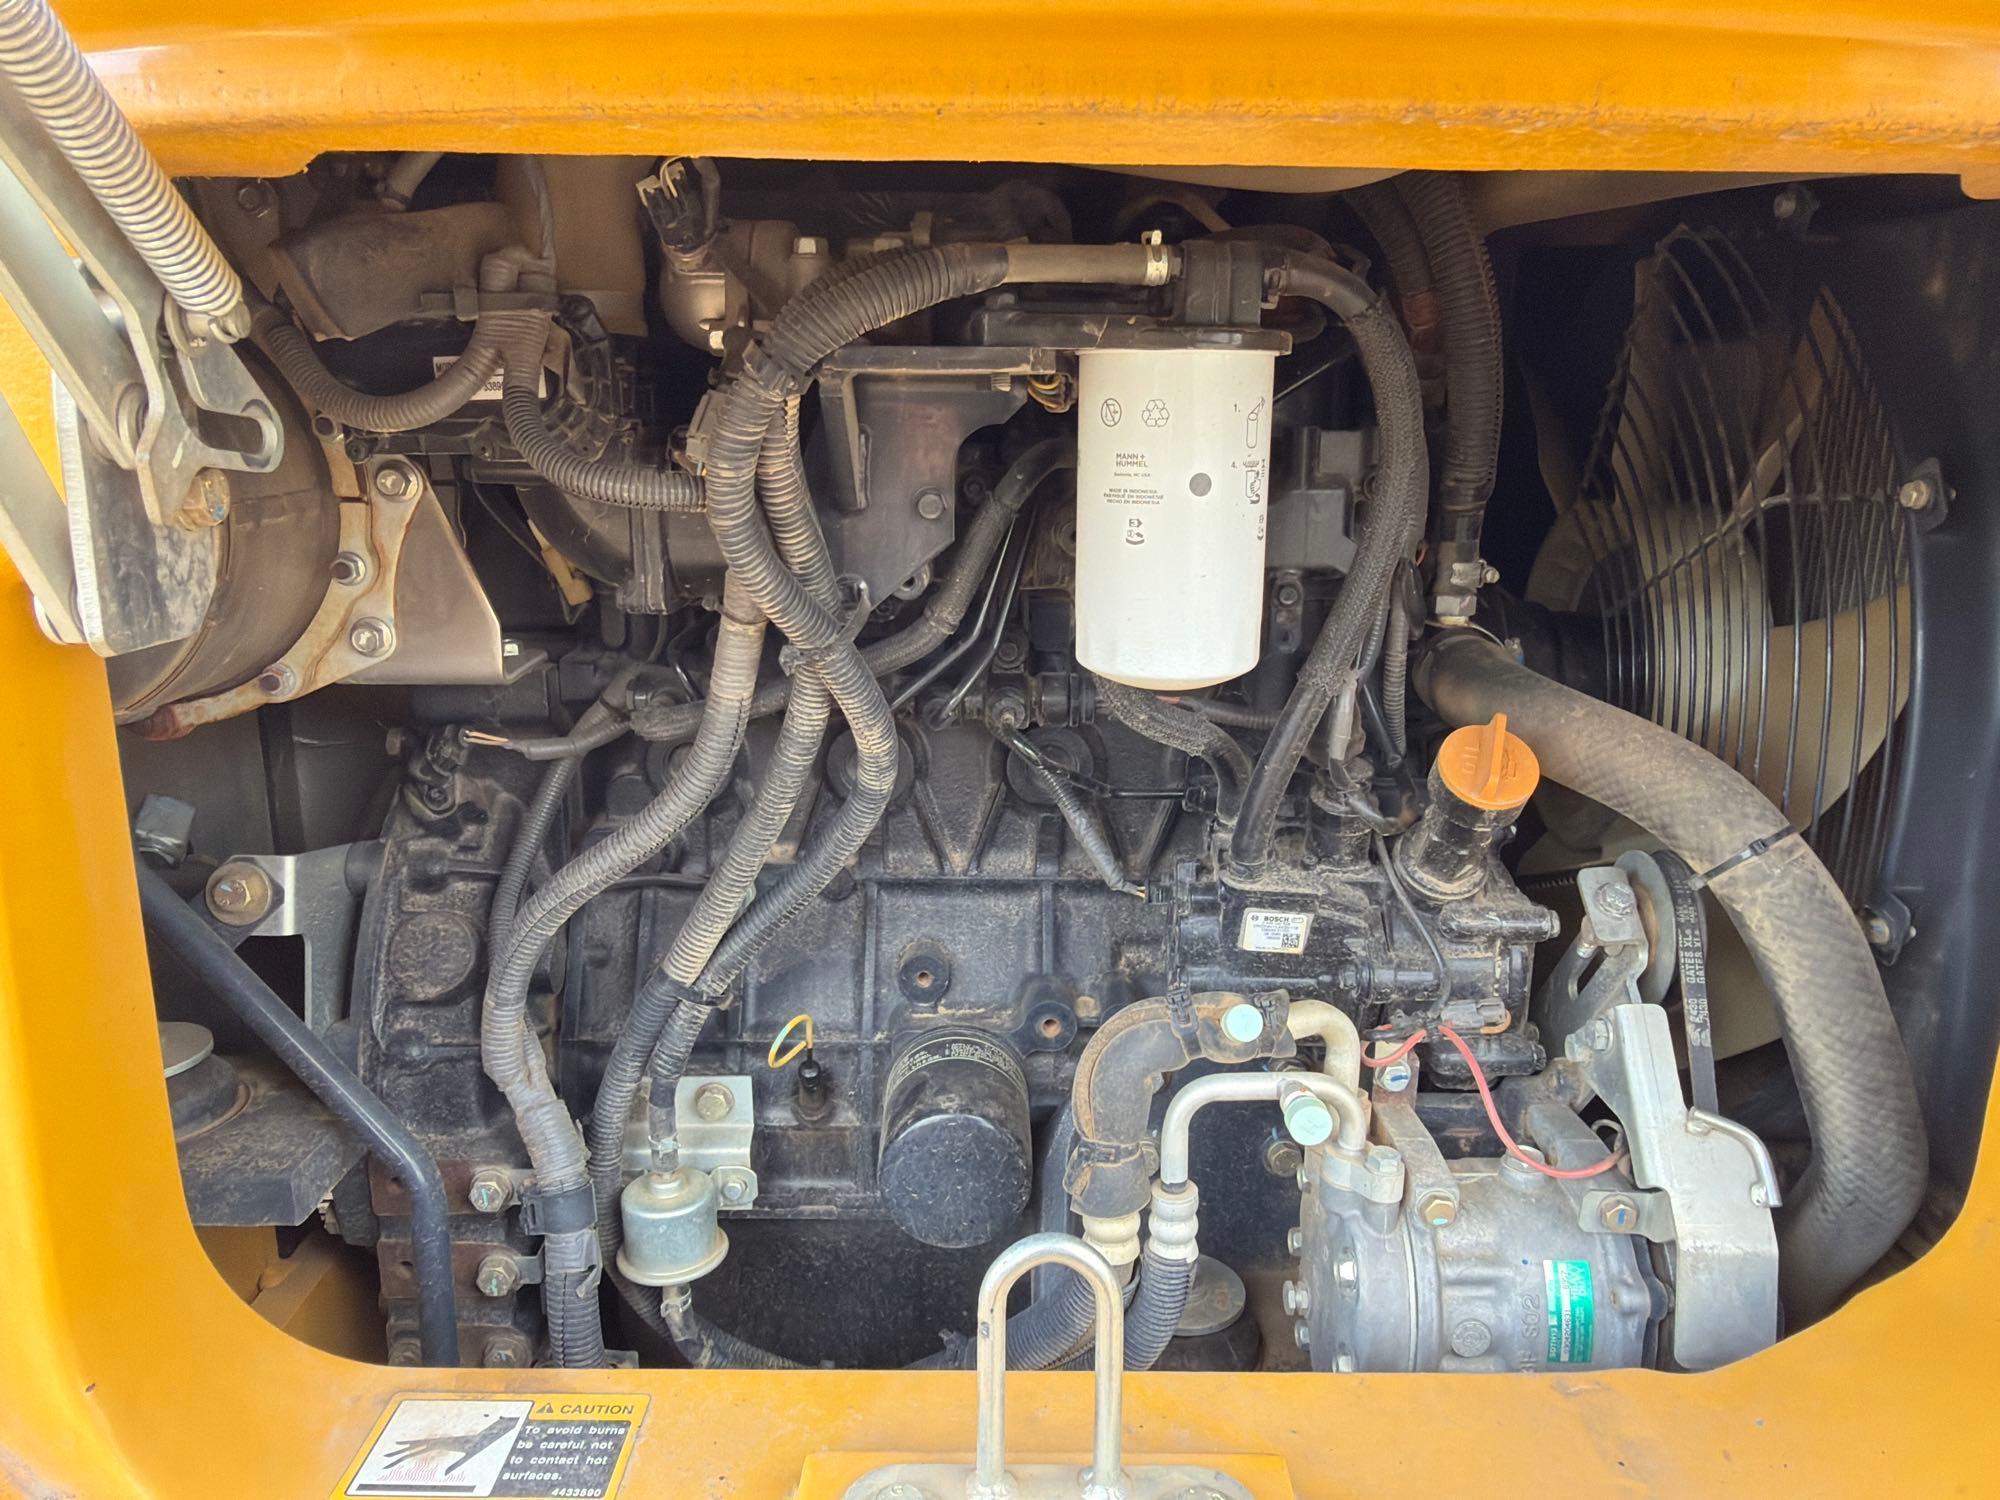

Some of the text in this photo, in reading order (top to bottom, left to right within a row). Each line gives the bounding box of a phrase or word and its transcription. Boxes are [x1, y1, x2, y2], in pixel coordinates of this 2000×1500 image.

[1234, 402, 1241, 413] 1.
[1116, 460, 1149, 468] HUMMEL
[1684, 951, 1696, 984] GATES
[560, 1404, 634, 1415] CAUTION
[525, 1425, 625, 1435] To avoid burns
[517, 1440, 533, 1449] be
[510, 1455, 608, 1465] to contact hot
[502, 1471, 562, 1480] surfaces.
